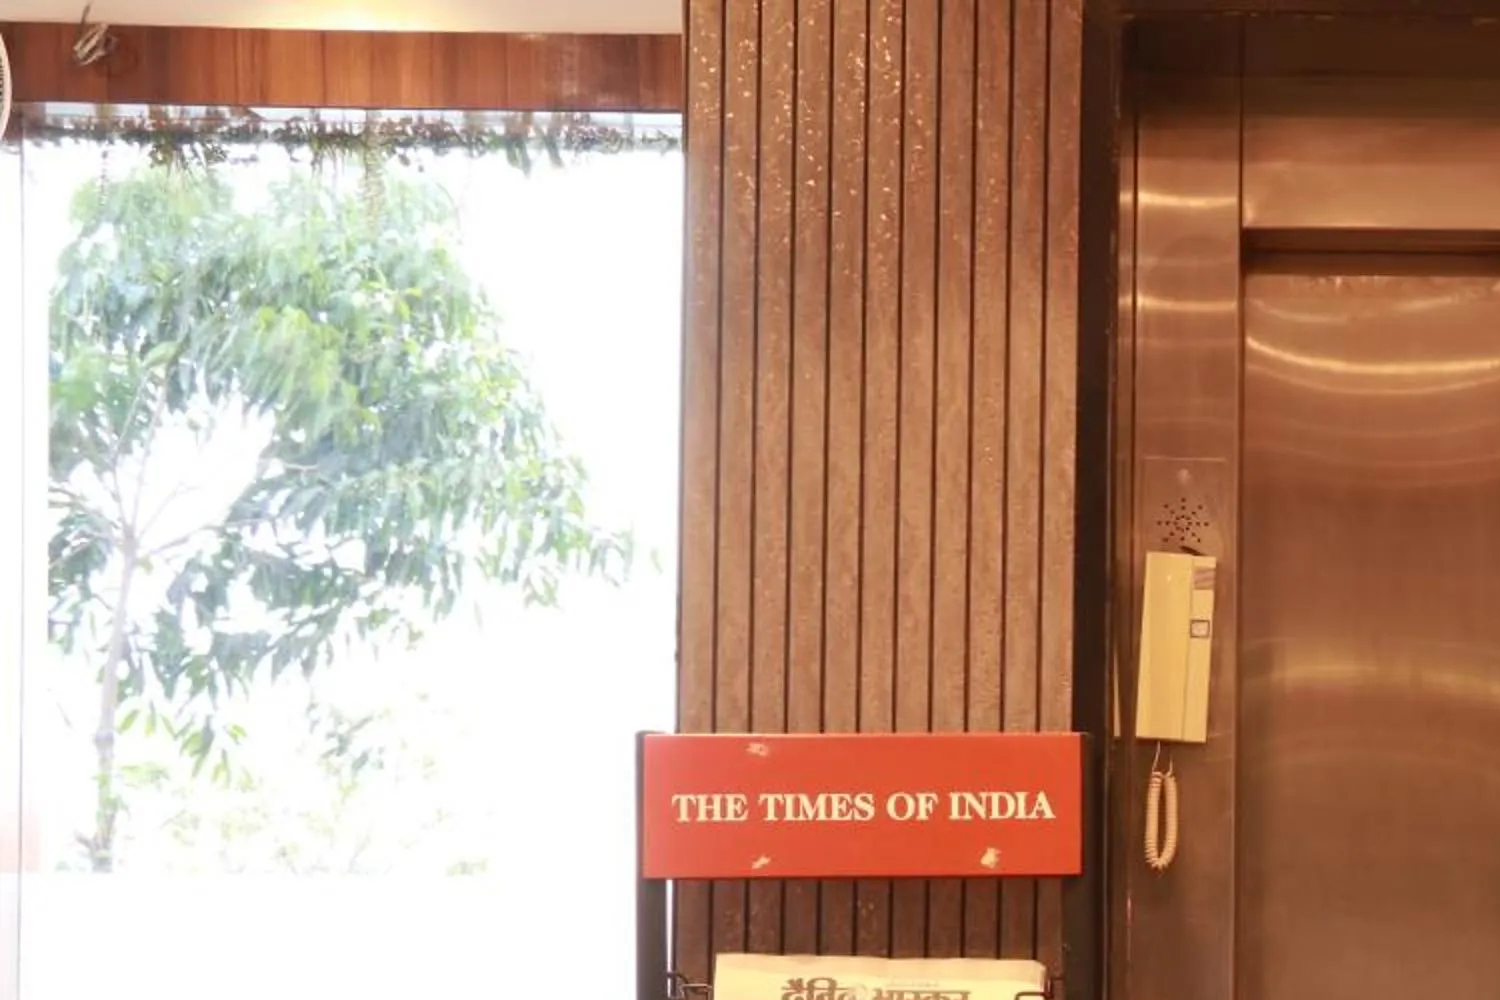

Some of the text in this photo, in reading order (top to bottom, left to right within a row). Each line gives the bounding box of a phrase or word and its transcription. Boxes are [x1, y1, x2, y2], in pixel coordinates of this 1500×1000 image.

[672, 791, 1057, 823] THE TIMES OF INDIA
